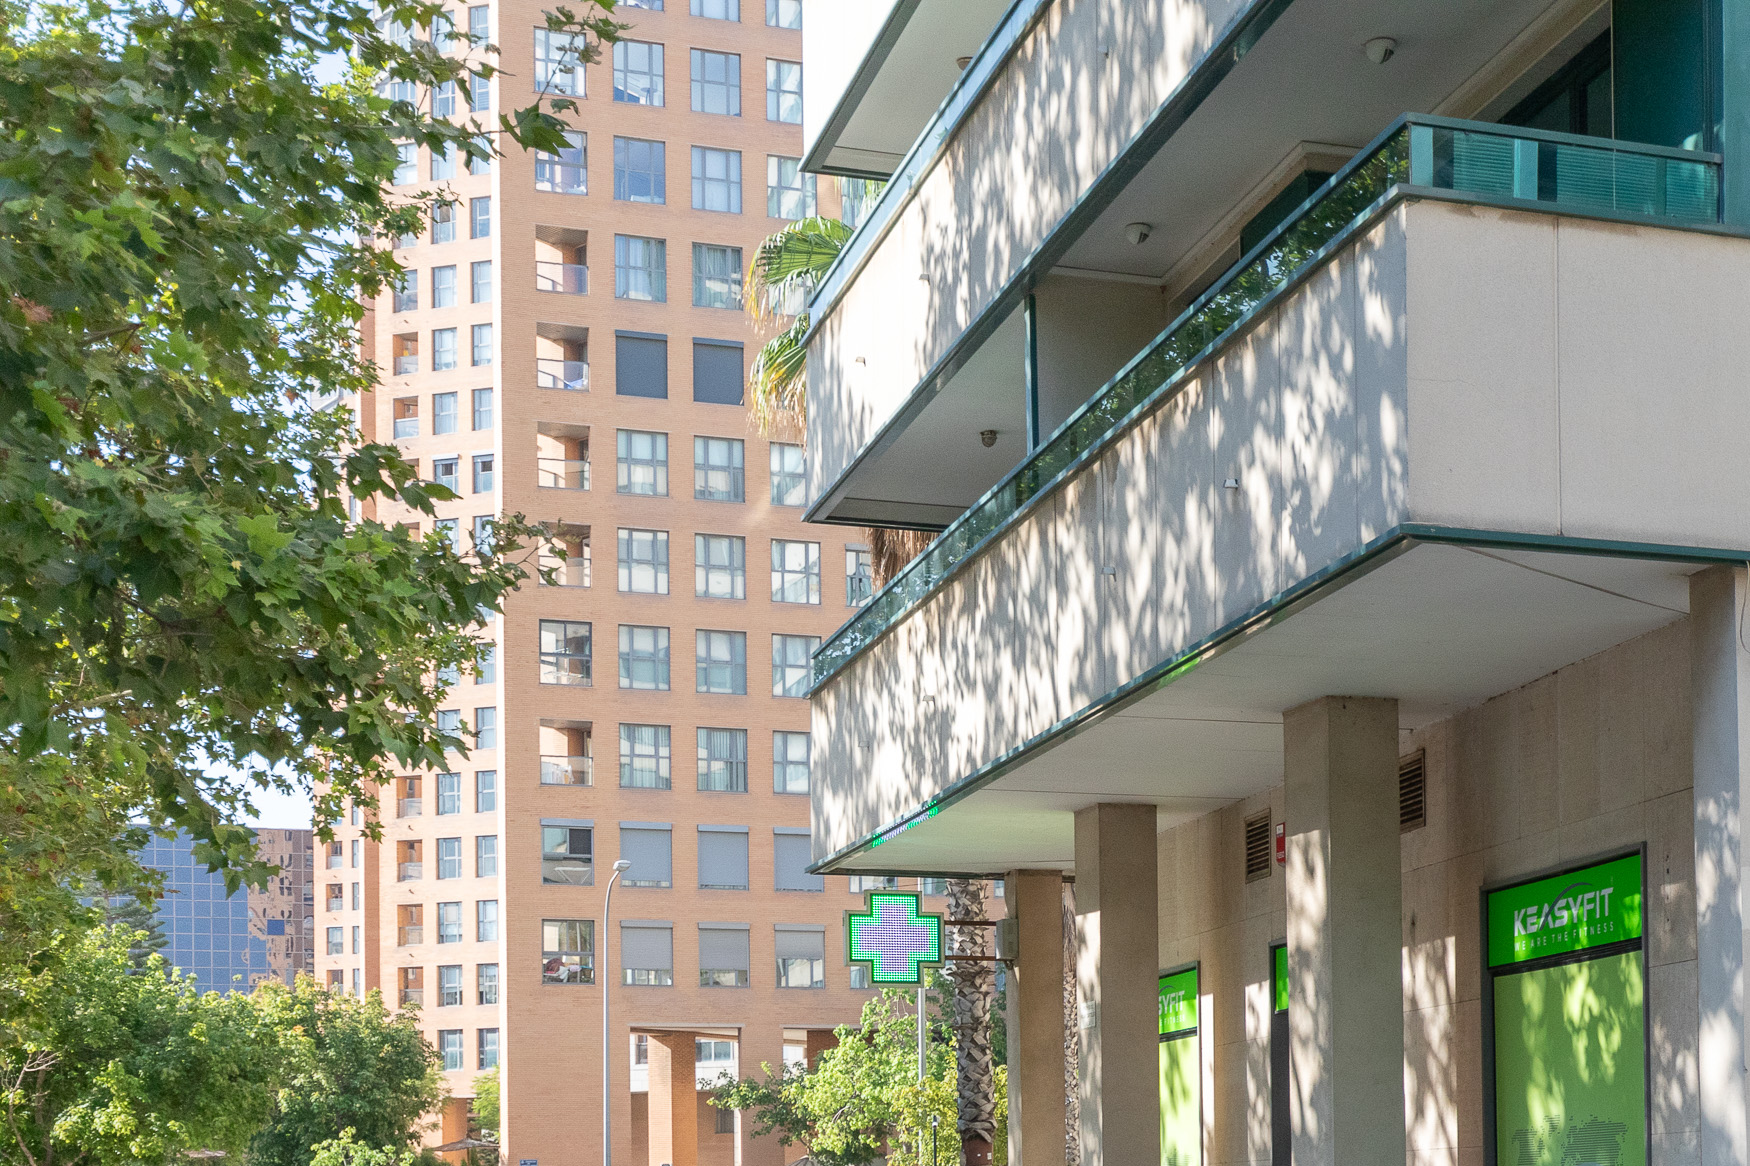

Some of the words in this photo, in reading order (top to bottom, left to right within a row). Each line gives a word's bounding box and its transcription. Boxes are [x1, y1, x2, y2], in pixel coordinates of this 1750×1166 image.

[1514, 887, 1614, 937] KEASYFIT
[1530, 936, 1547, 947] ARE
[1552, 932, 1568, 943] THE
[1573, 921, 1614, 939] FITNESS
